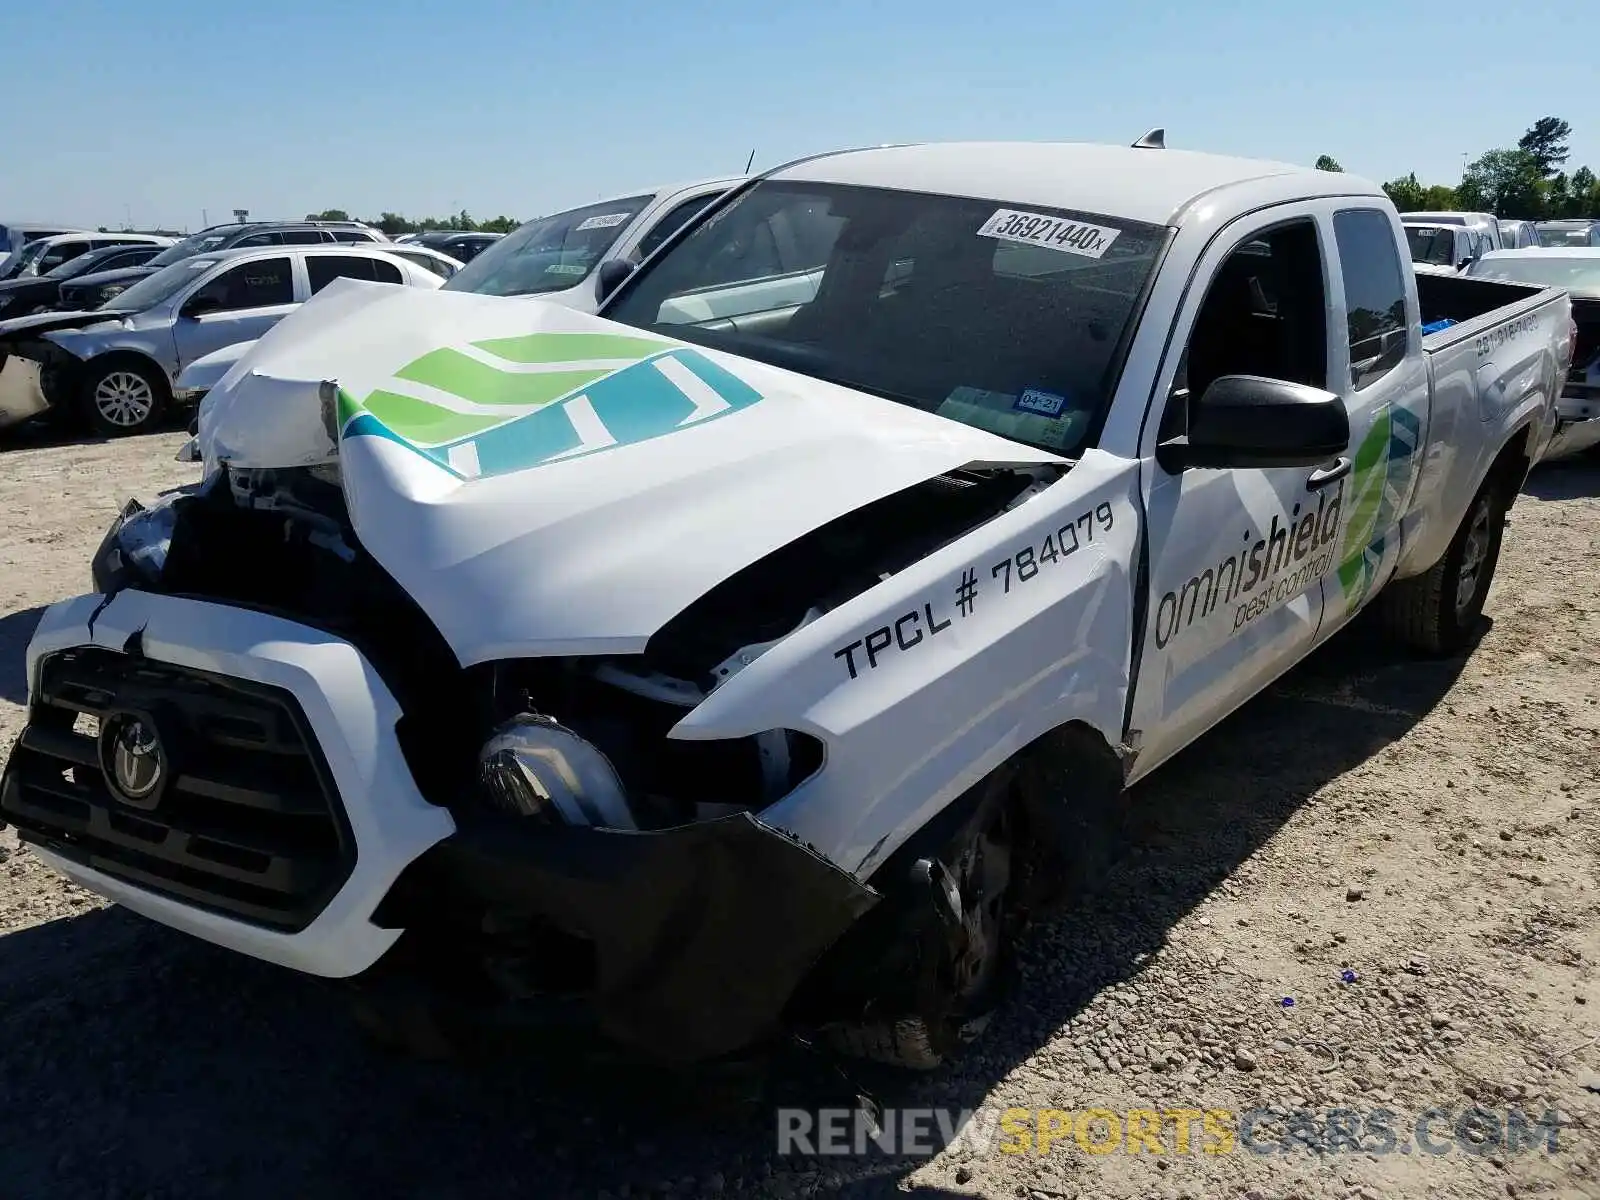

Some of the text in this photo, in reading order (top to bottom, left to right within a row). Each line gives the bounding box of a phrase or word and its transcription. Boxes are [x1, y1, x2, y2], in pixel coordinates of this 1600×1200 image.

[834, 501, 1114, 680] TPCL # 784079
[1155, 478, 1345, 650] omnishield
[1232, 549, 1334, 633] pest control
